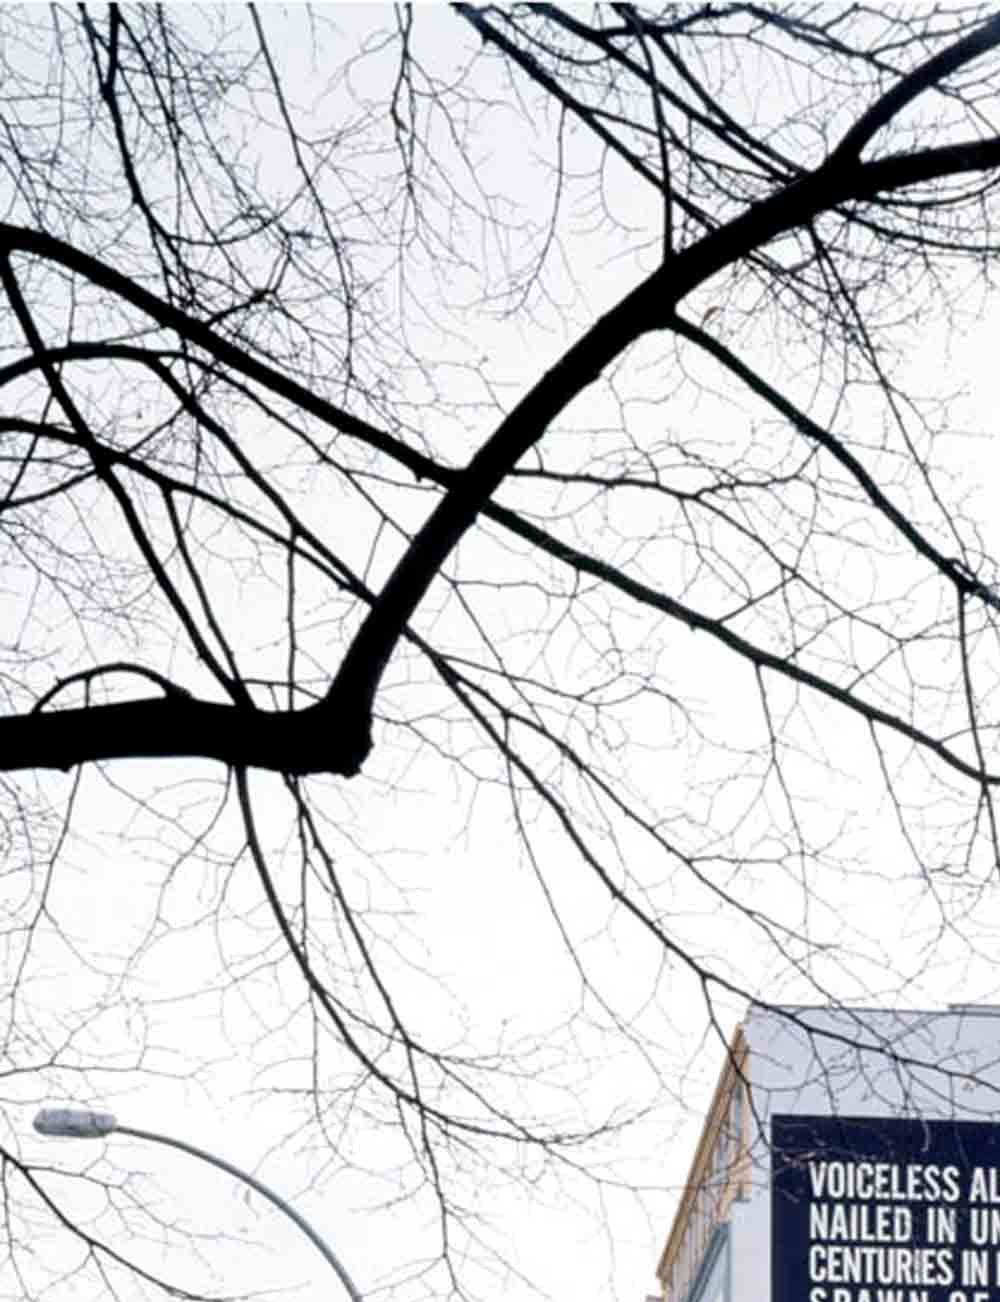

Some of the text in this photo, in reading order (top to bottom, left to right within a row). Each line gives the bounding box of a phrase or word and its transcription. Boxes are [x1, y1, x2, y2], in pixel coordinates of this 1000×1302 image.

[811, 1162, 961, 1201] VOICELESS
[810, 1204, 913, 1241] NAILED
[928, 1208, 956, 1242] IN
[810, 1247, 955, 1284] CENTURIES
[962, 1251, 989, 1285] IN
